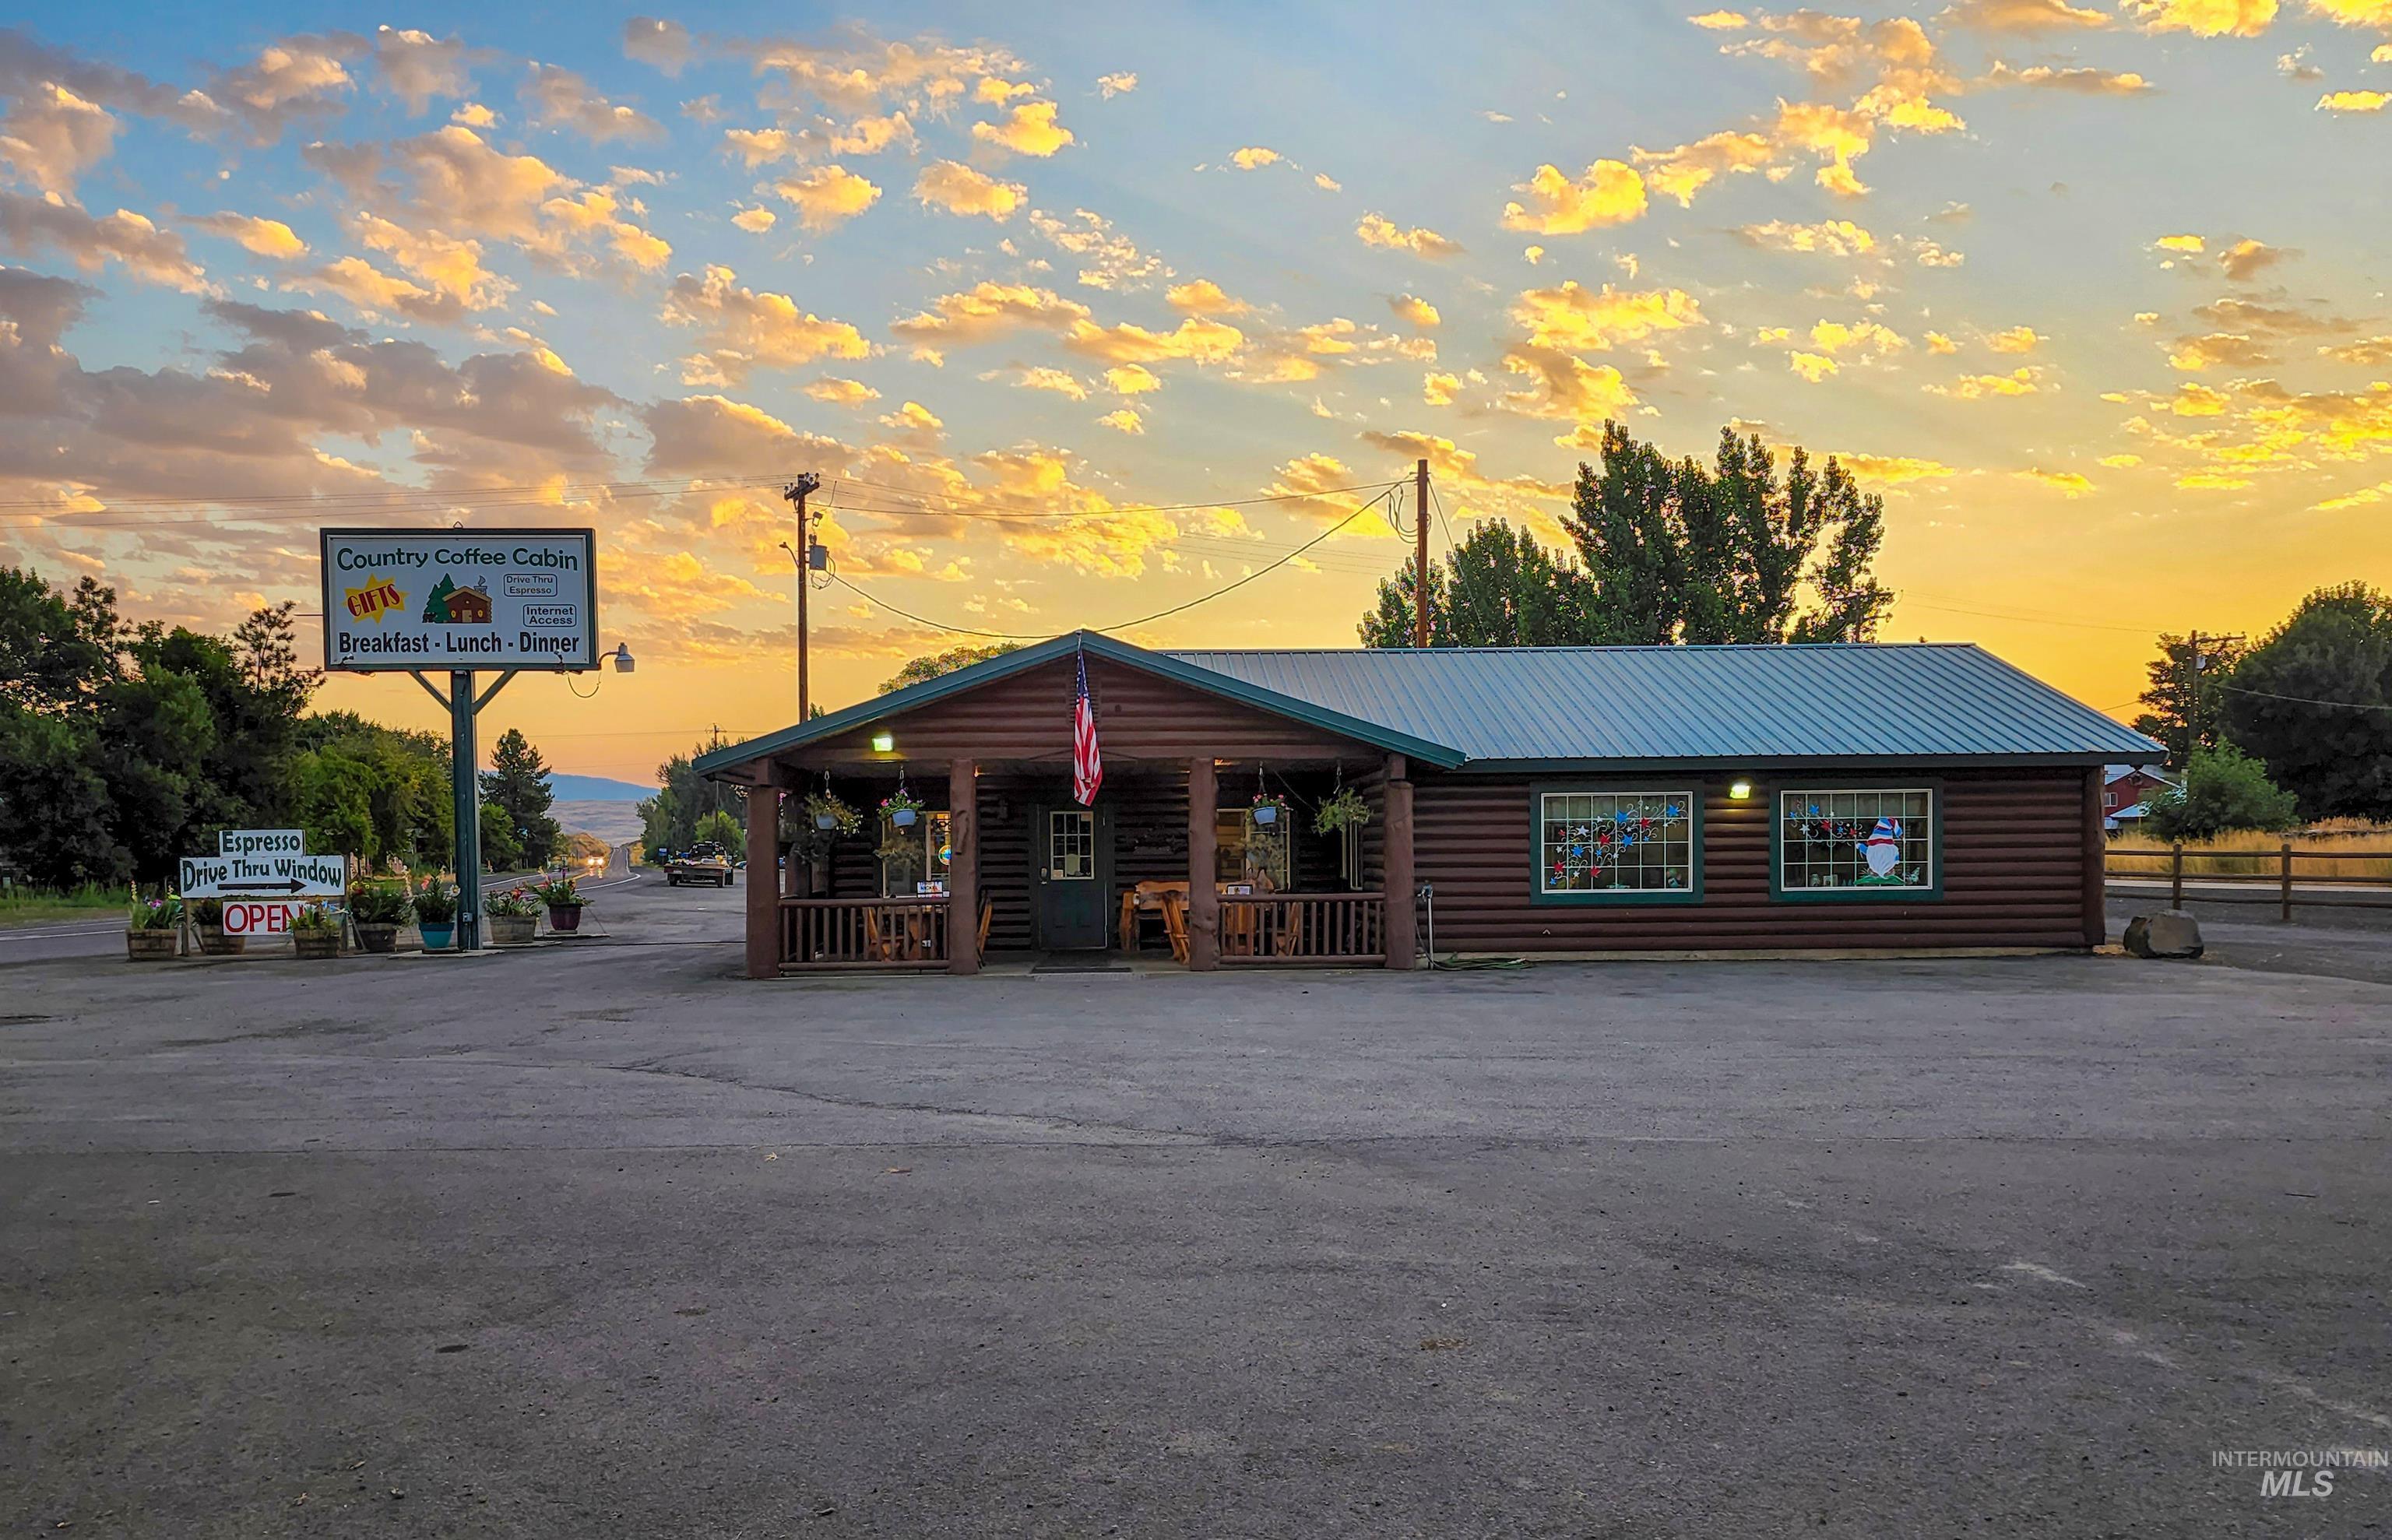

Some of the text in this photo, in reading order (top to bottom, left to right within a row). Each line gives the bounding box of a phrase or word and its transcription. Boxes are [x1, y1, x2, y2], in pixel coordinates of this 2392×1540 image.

[337, 547, 578, 571] Country Coffee Cabin
[347, 584, 400, 617] GIFTS
[509, 586, 552, 595] Espresso
[526, 607, 573, 615] Internet
[529, 615, 573, 624] Access
[339, 631, 579, 653] Breakfast Lunch Dinner
[222, 831, 301, 856] Espresso
[182, 858, 342, 892] Drive Thru Window
